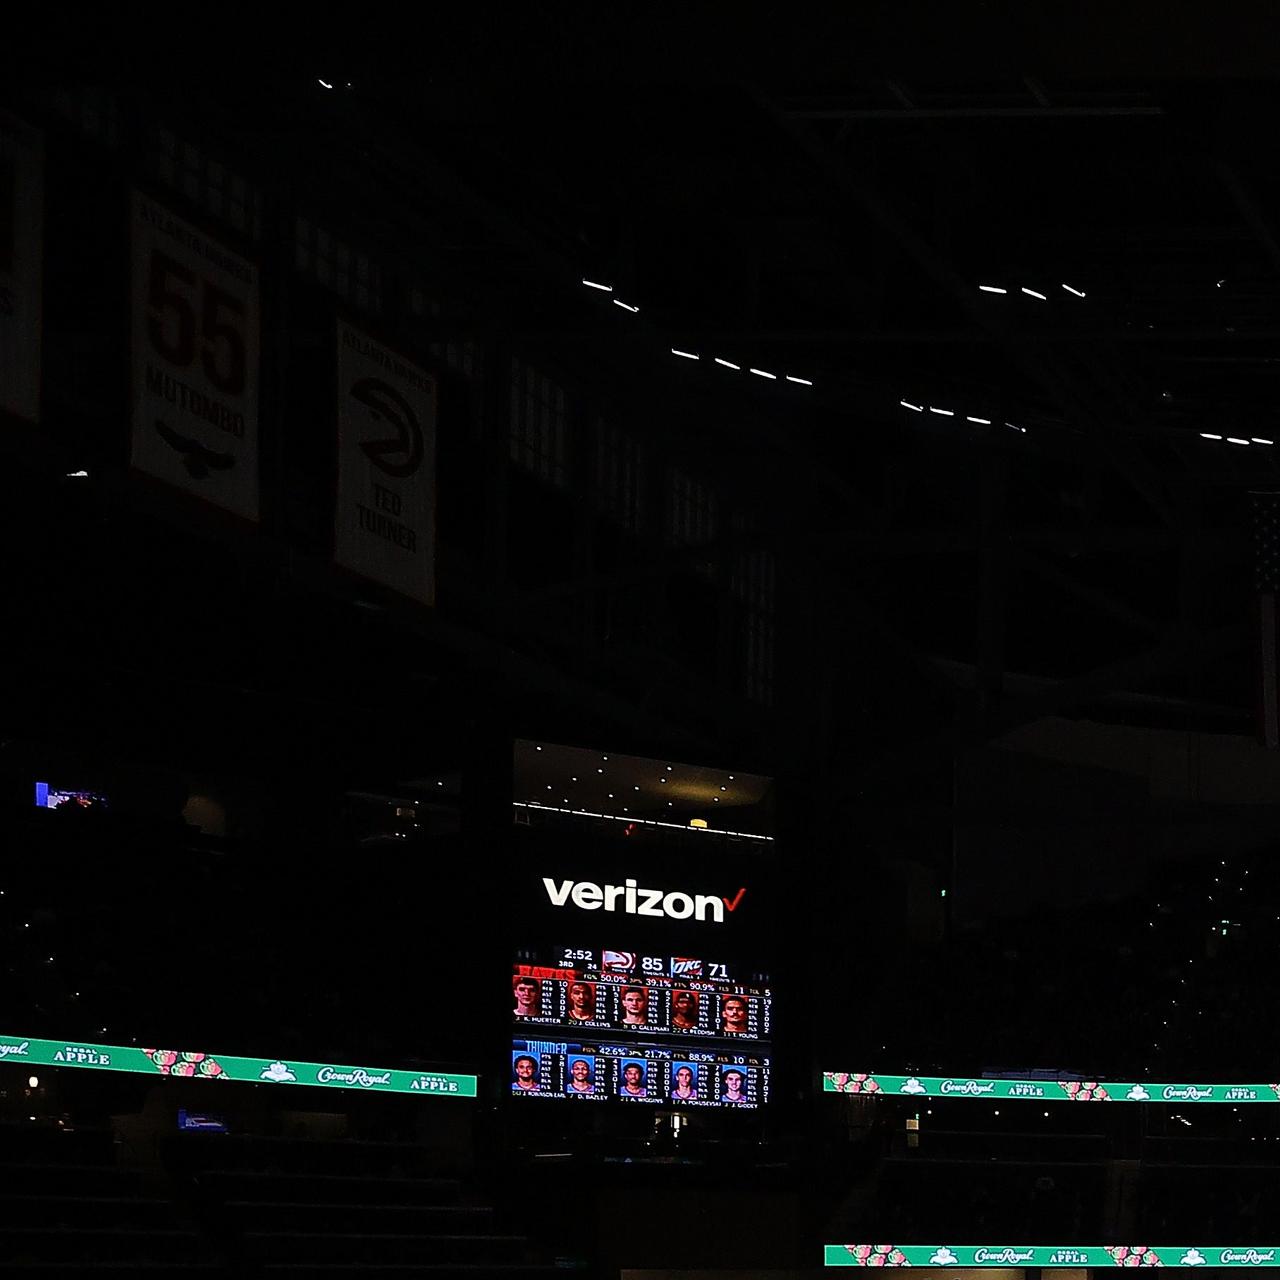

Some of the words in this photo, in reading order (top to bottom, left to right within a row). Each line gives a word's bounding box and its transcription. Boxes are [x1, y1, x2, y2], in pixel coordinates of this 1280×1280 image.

[145, 249, 246, 396] 55
[145, 361, 245, 439] MUTOMBO
[373, 483, 401, 517] TED
[357, 504, 417, 554] TURNER
[542, 877, 724, 923] verizon
[564, 948, 593, 961] 2:52
[558, 960, 574, 968] 3RD
[641, 956, 663, 971] 85
[707, 963, 728, 978] 71
[600, 974, 627, 984] 50.0%
[645, 977, 672, 988] 39.1%
[689, 982, 716, 992] 90.9%
[734, 986, 745, 995] 11
[764, 988, 771, 997] 5
[599, 1047, 626, 1056] 42.6%
[644, 1050, 671, 1059] 21.7%
[688, 1053, 715, 1062] 88.9%
[733, 1056, 745, 1065] 10
[763, 1058, 770, 1066] 3
[411, 1080, 457, 1092] APPLE
[1009, 1084, 1044, 1096] APPLE
[1050, 1251, 1088, 1263] APPLE
